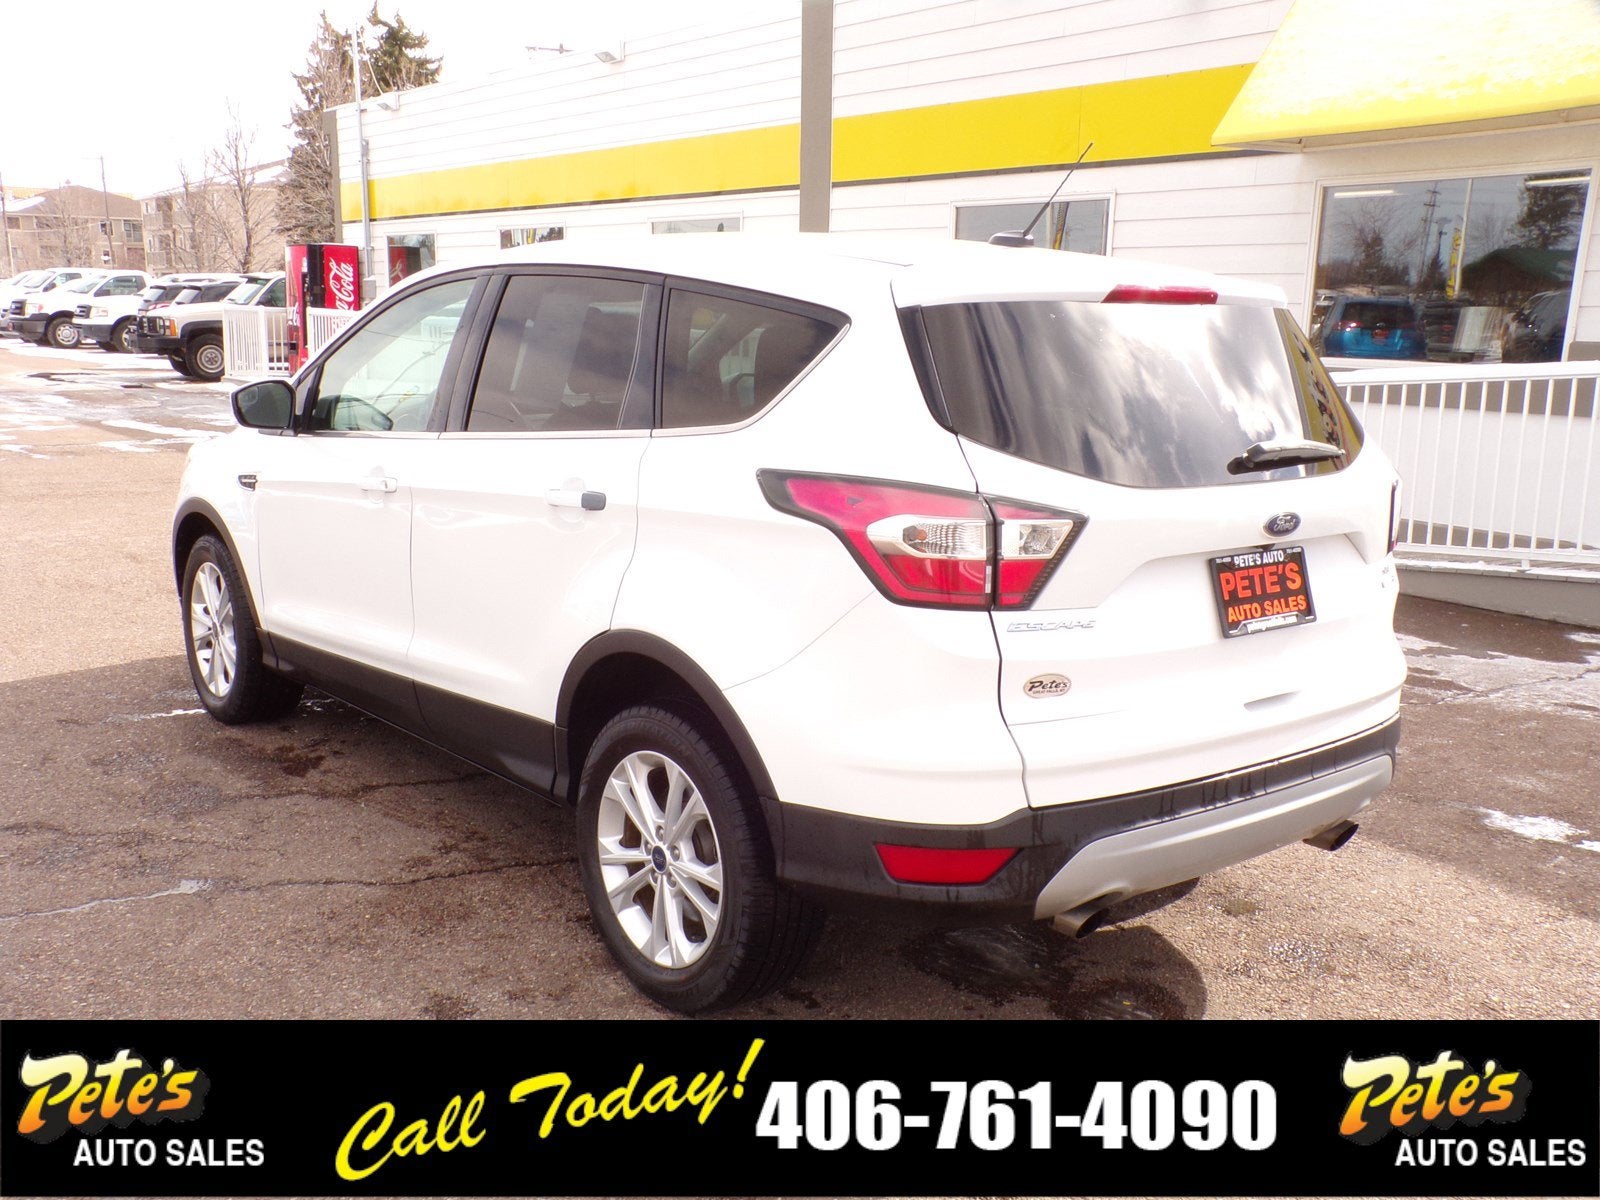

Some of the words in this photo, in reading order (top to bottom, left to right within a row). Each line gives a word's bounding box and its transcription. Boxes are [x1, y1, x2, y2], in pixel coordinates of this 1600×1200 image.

[1273, 516, 1296, 531] Ford
[1233, 553, 1261, 568] PETE'S
[1263, 550, 1285, 564] AUTO
[1220, 562, 1302, 600] PETE'S
[1228, 602, 1261, 622] AUTO
[1264, 595, 1307, 616] SALES
[1007, 620, 1096, 632] ESCAPE
[1028, 680, 1068, 691] Pete's
